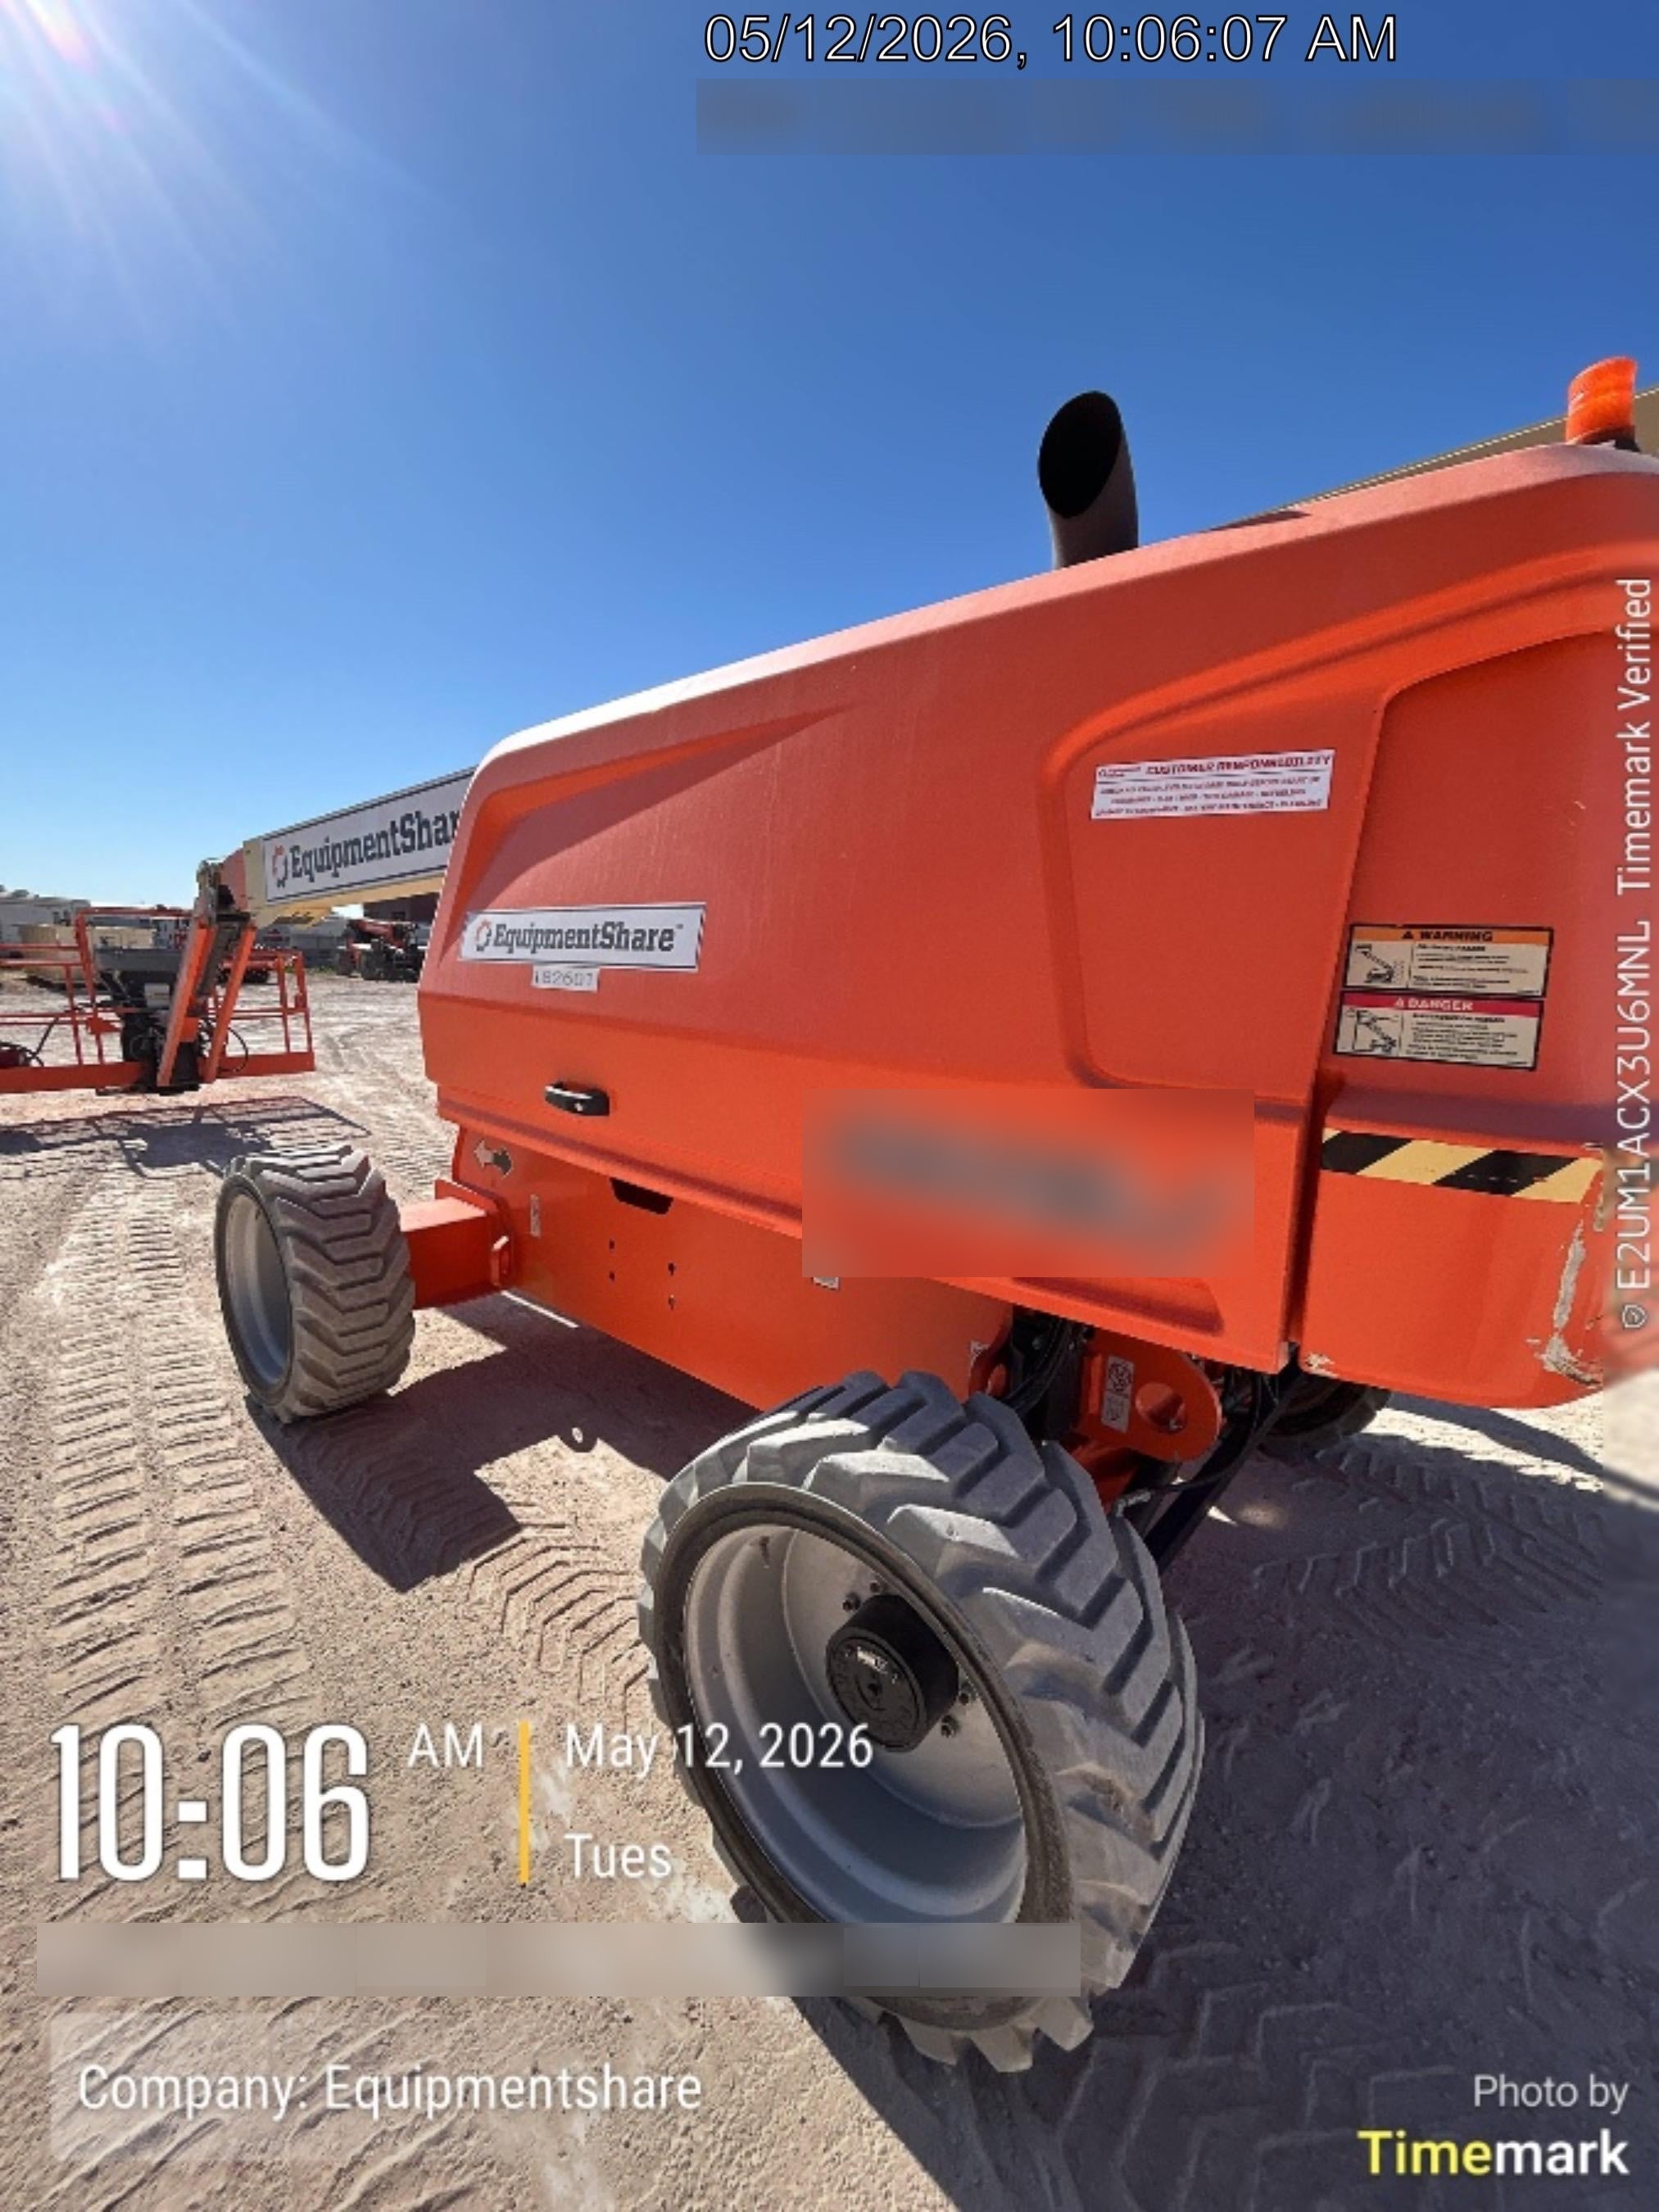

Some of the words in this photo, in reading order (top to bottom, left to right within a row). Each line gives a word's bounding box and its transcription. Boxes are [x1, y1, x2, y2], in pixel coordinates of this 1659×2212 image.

[289, 809, 460, 882] EquipmentShar
[494, 921, 674, 954] EquipmentShare
[1420, 931, 1494, 942] WARNING
[1407, 997, 1474, 1011] DANGER
